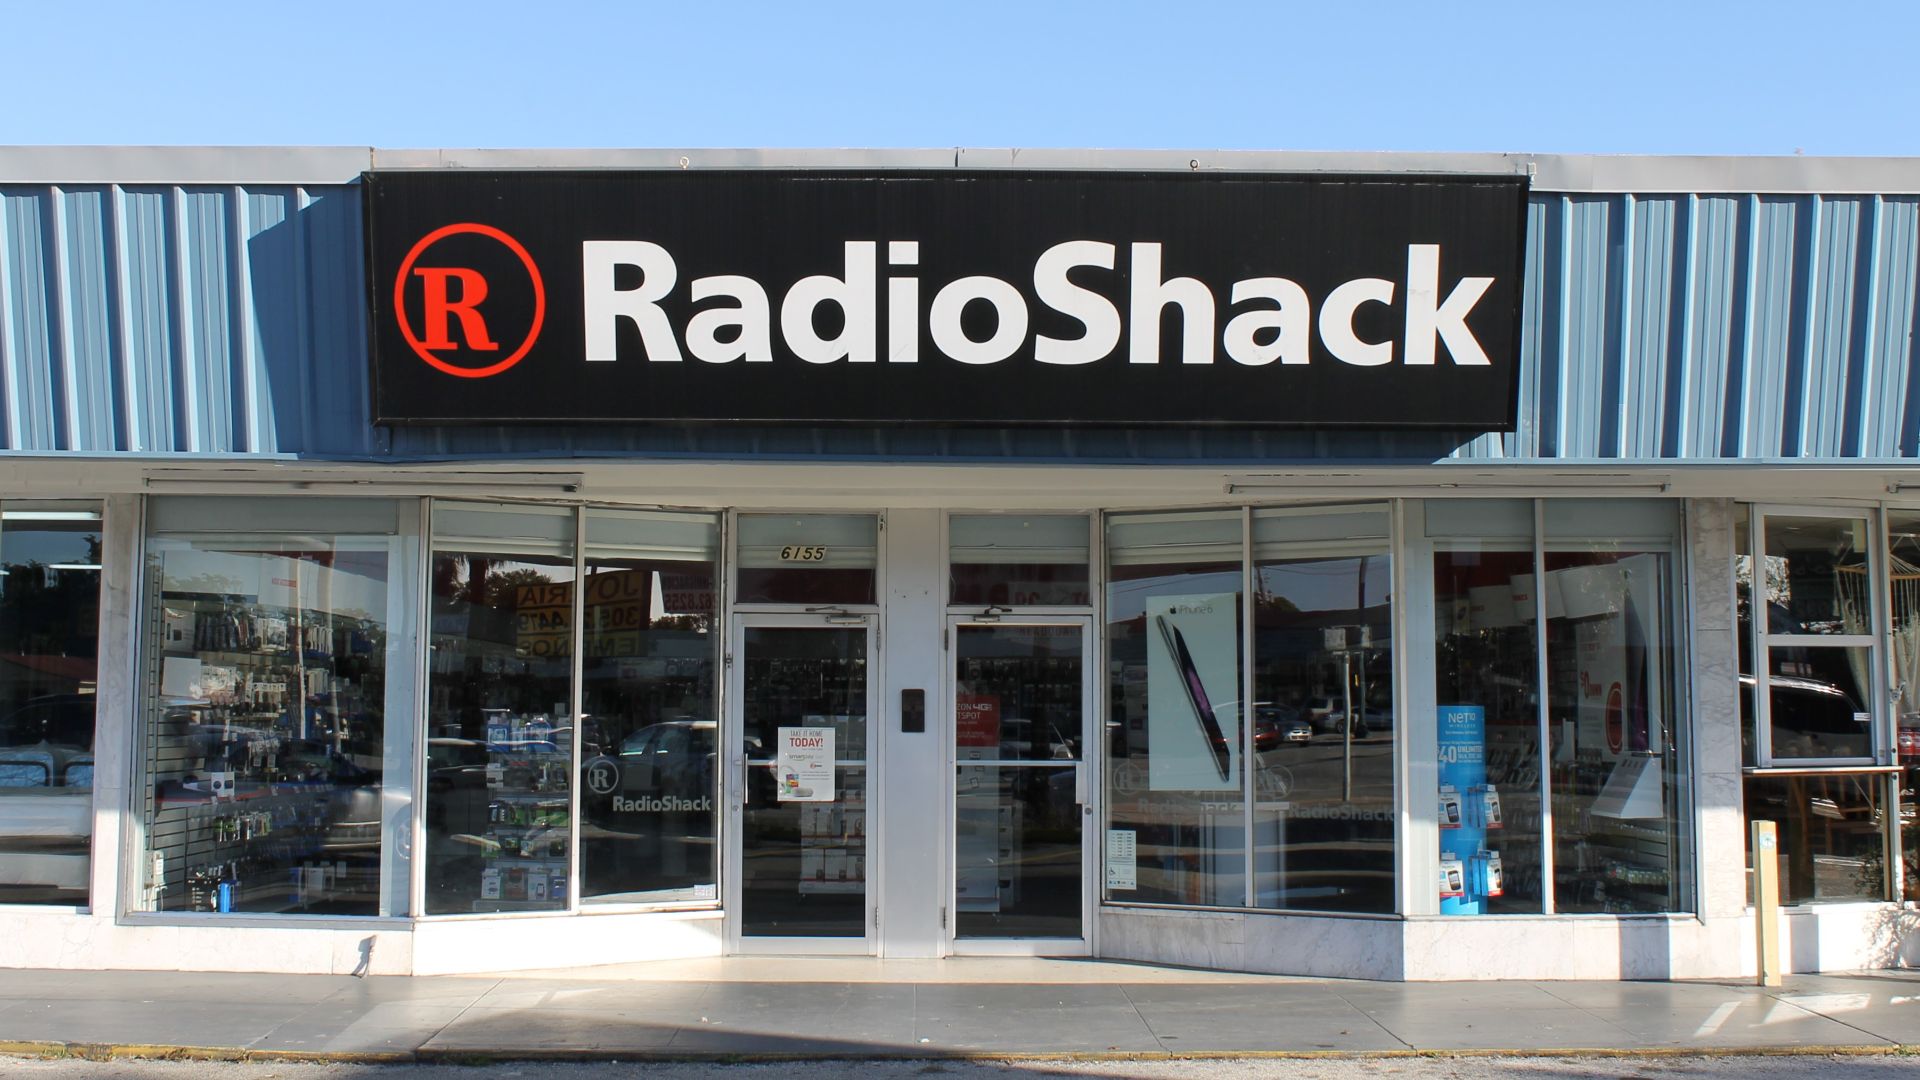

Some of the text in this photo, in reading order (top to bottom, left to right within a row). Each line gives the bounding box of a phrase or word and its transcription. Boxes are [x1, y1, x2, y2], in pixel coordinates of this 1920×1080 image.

[582, 239, 1496, 368] RadioShack
[780, 546, 825, 560] 6155
[1178, 605, 1206, 615] iPhone
[789, 738, 824, 747] TODAY!
[613, 795, 711, 812] RadioShack
